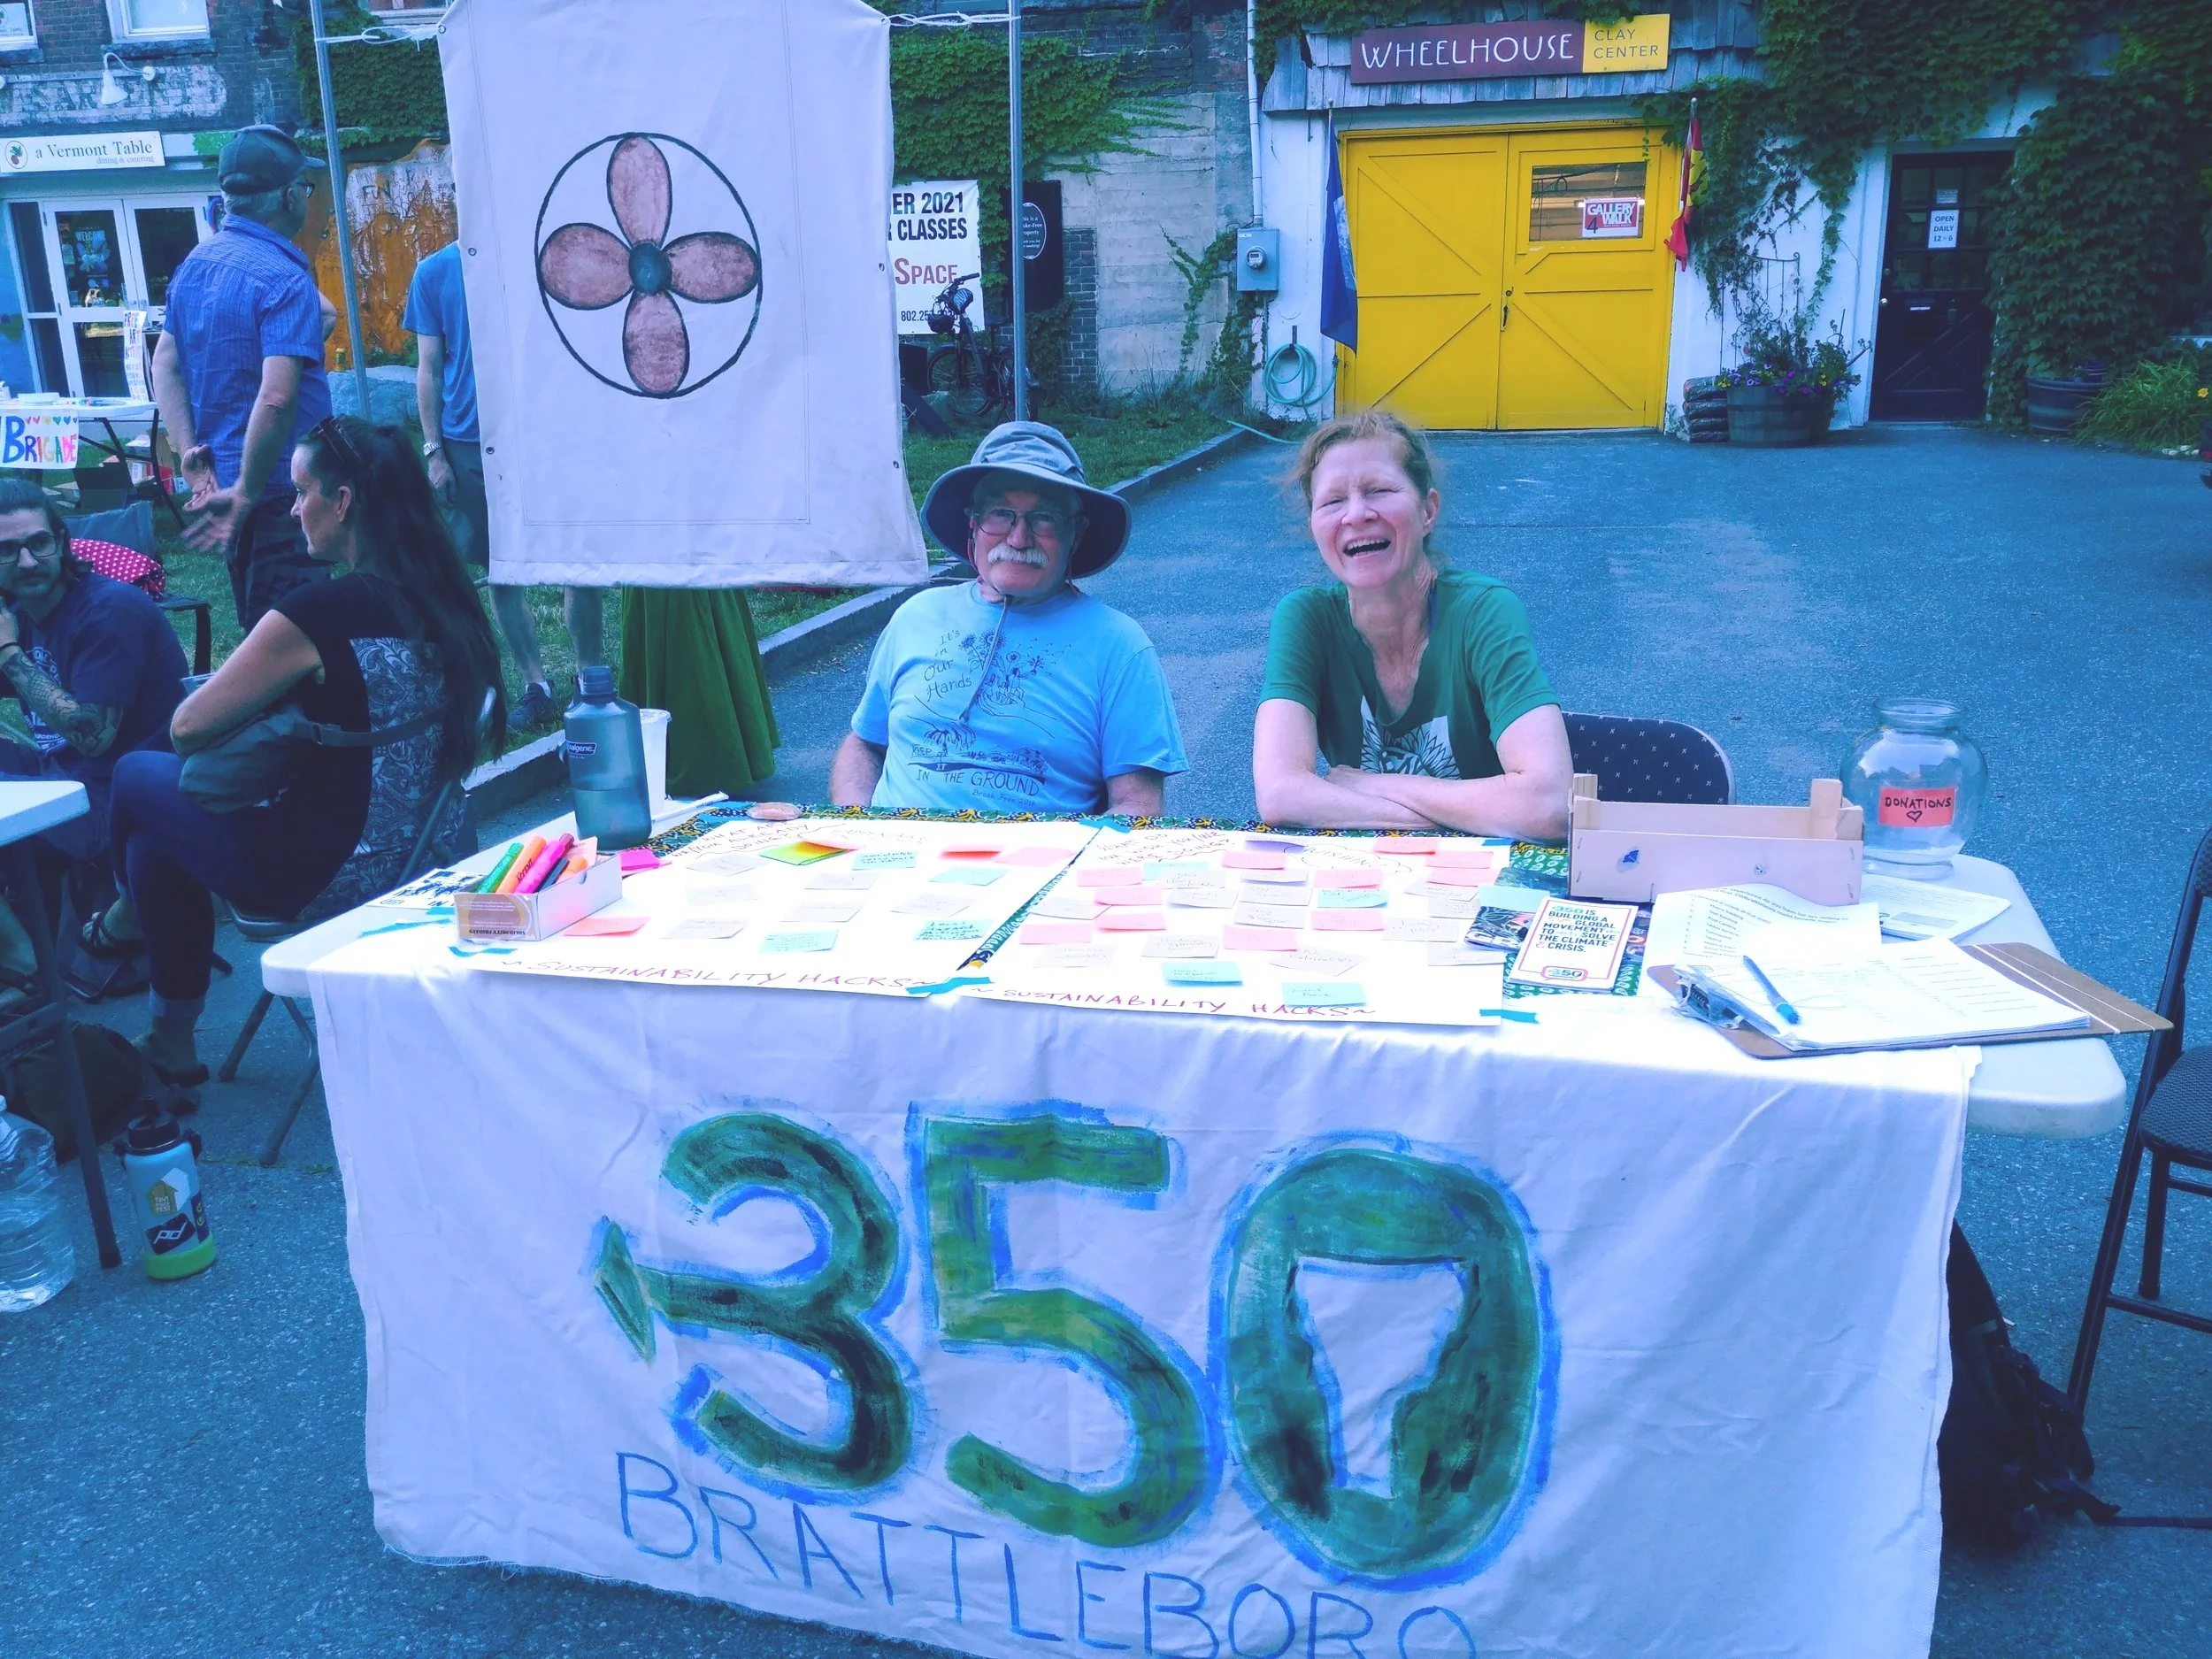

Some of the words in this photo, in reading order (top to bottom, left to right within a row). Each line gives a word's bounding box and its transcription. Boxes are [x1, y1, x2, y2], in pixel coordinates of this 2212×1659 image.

[1594, 27, 1637, 42] CLAY
[1360, 33, 1575, 70] WHEELHOUSE
[1593, 45, 1660, 59] CENTER
[35, 147, 42, 158] a
[47, 143, 108, 157] Vermont
[112, 141, 153, 155] Table
[921, 191, 964, 214] 2021
[1587, 203, 1636, 215] GALLERY
[1586, 217, 1598, 234] 4
[1601, 213, 1633, 225] WALK
[897, 218, 968, 242] CLASSES
[3, 415, 77, 463] BRIGADE
[940, 630, 960, 646] It's
[934, 648, 948, 657] in
[924, 659, 954, 681] Our
[926, 673, 972, 703] Hands
[935, 763, 947, 772] IT
[915, 768, 930, 781] IN
[943, 772, 965, 784] THE
[970, 771, 1040, 796] GROUND
[1885, 796, 1952, 810] DONATIONS
[1548, 910, 1599, 922] BUILDING
[1575, 919, 1616, 928] GLOBAL
[1543, 922, 1604, 933] MOVEMENT
[1539, 933, 1560, 942] THE
[1561, 936, 1609, 948] CLIMATE
[1581, 932, 1617, 941] SOLVE
[1548, 941, 1586, 953] CRISIS.
[528, 961, 787, 986] SUSTAINABILITY
[798, 973, 910, 987] HACKS
[1551, 968, 1583, 978] 350
[1003, 989, 1227, 1013] SUSTAINABILITY
[1252, 1002, 1350, 1017] HACKS
[595, 1100, 1561, 1587] 350
[616, 1451, 1476, 1659] BRATTLEBORO
